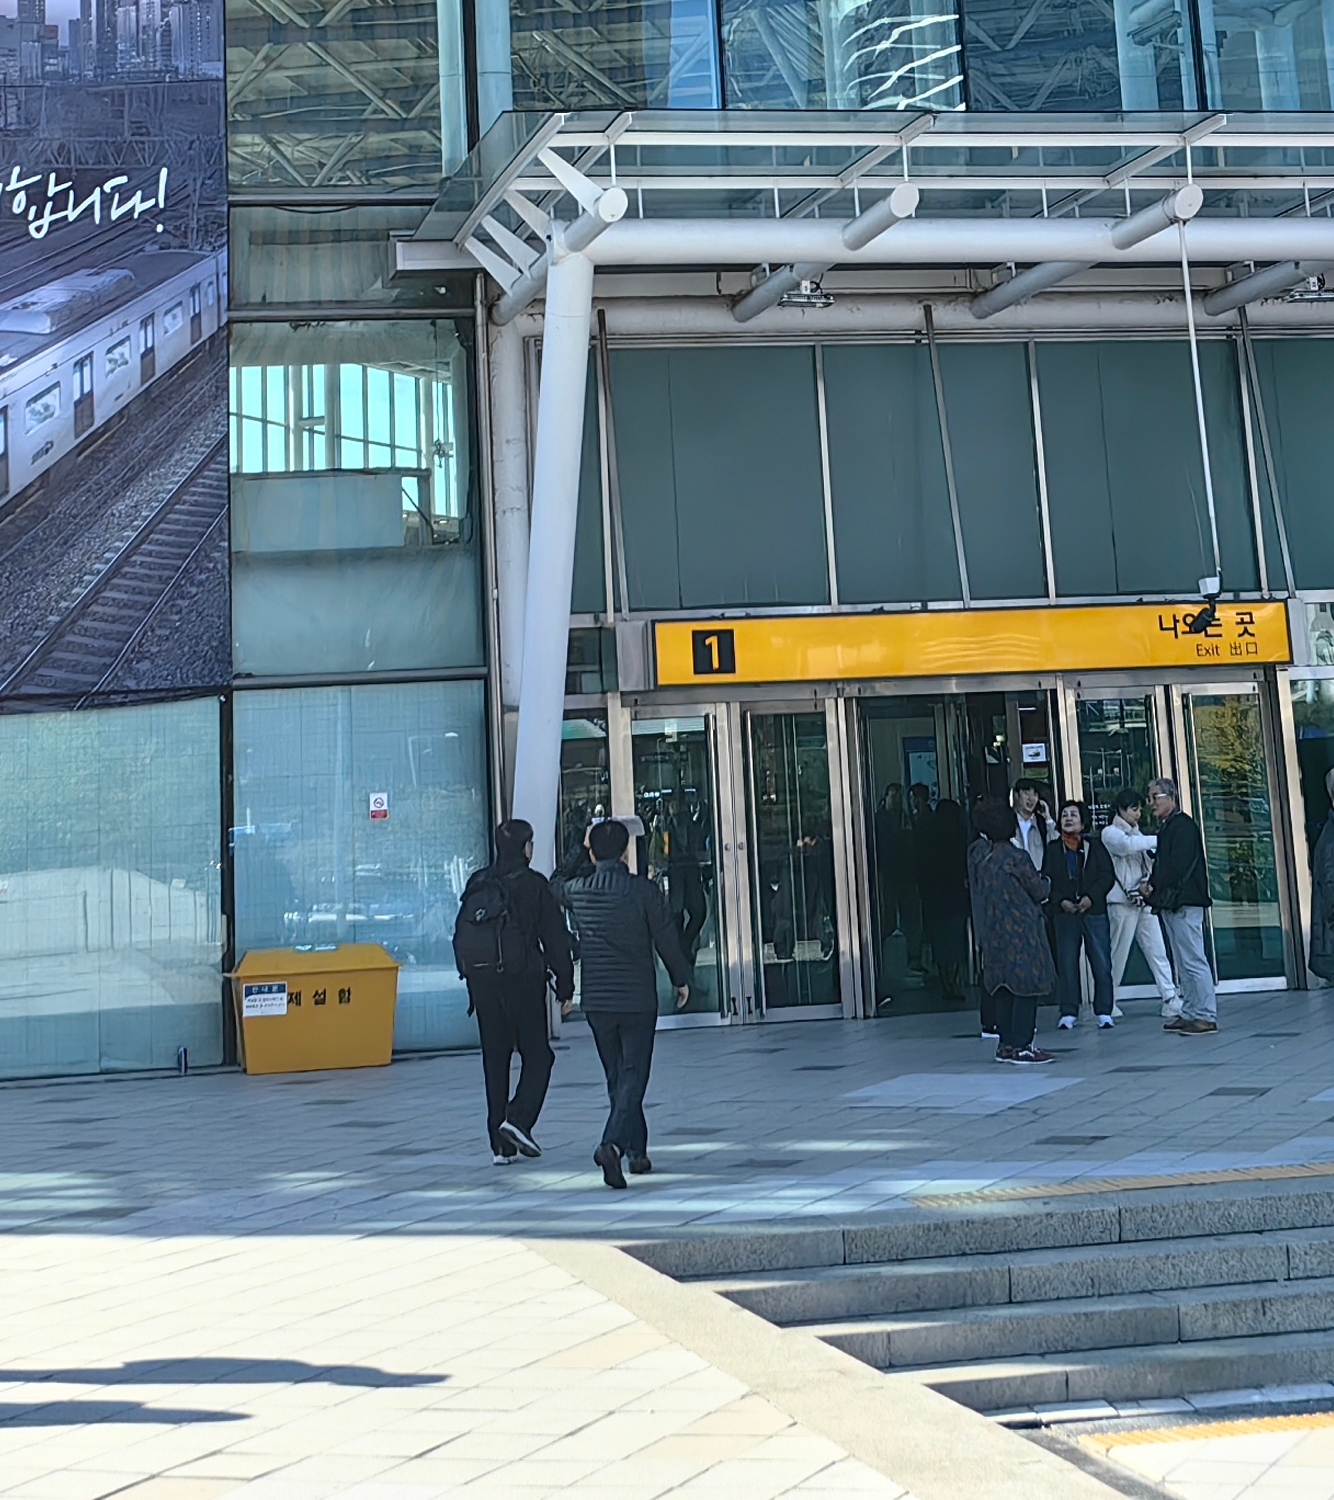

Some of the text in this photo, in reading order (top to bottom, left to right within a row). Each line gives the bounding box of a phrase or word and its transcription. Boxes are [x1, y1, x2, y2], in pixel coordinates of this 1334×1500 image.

[1235, 611, 1256, 638] 곳
[705, 635, 720, 671] 1
[1196, 641, 1258, 657] Exit 出口
